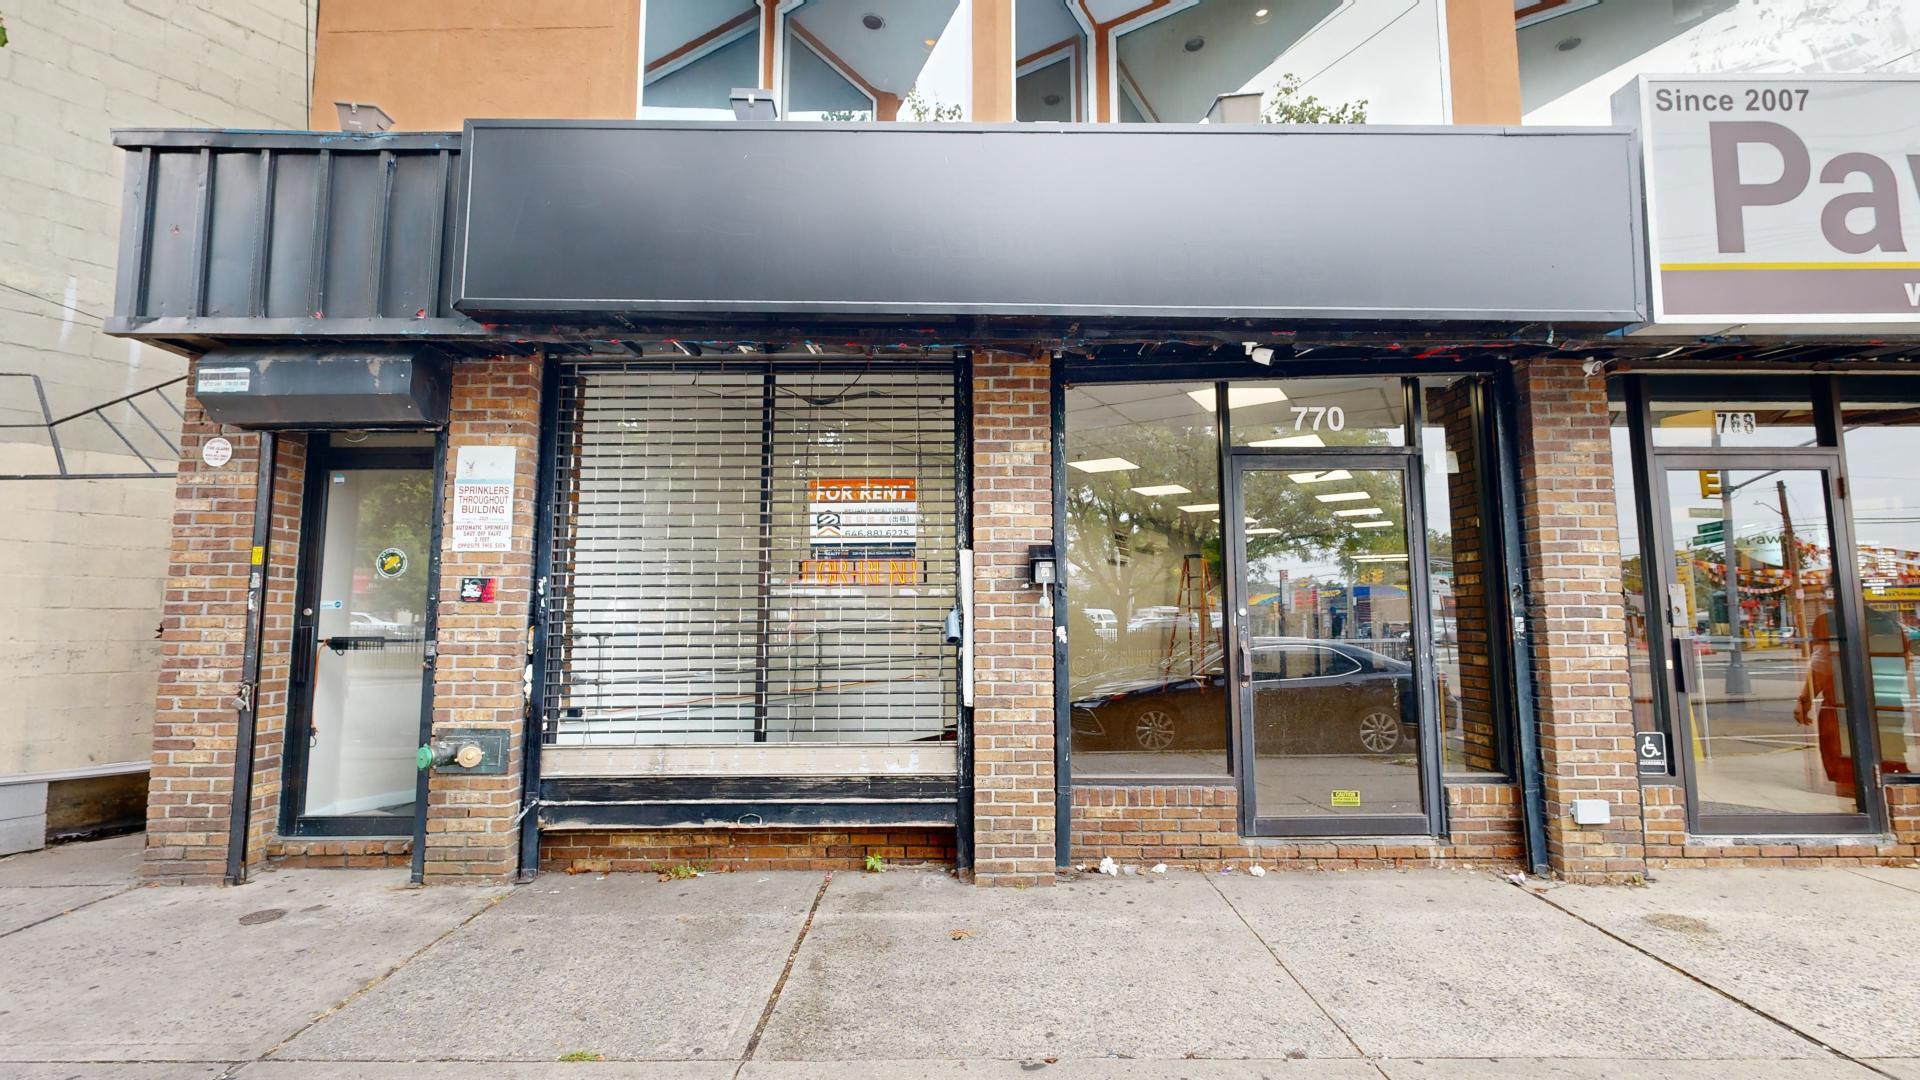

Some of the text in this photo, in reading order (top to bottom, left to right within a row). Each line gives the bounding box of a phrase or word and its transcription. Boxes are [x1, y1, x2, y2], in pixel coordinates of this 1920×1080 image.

[1655, 89, 1809, 112] Since 2007
[1709, 120, 1920, 254] Pa
[1290, 406, 1345, 431] 770
[1717, 413, 1754, 434] 768
[458, 486, 509, 495] SPRINKLERS
[816, 485, 910, 501] FOR RENT
[459, 496, 509, 504] THROUGHOUT
[462, 505, 505, 513] BUILDING
